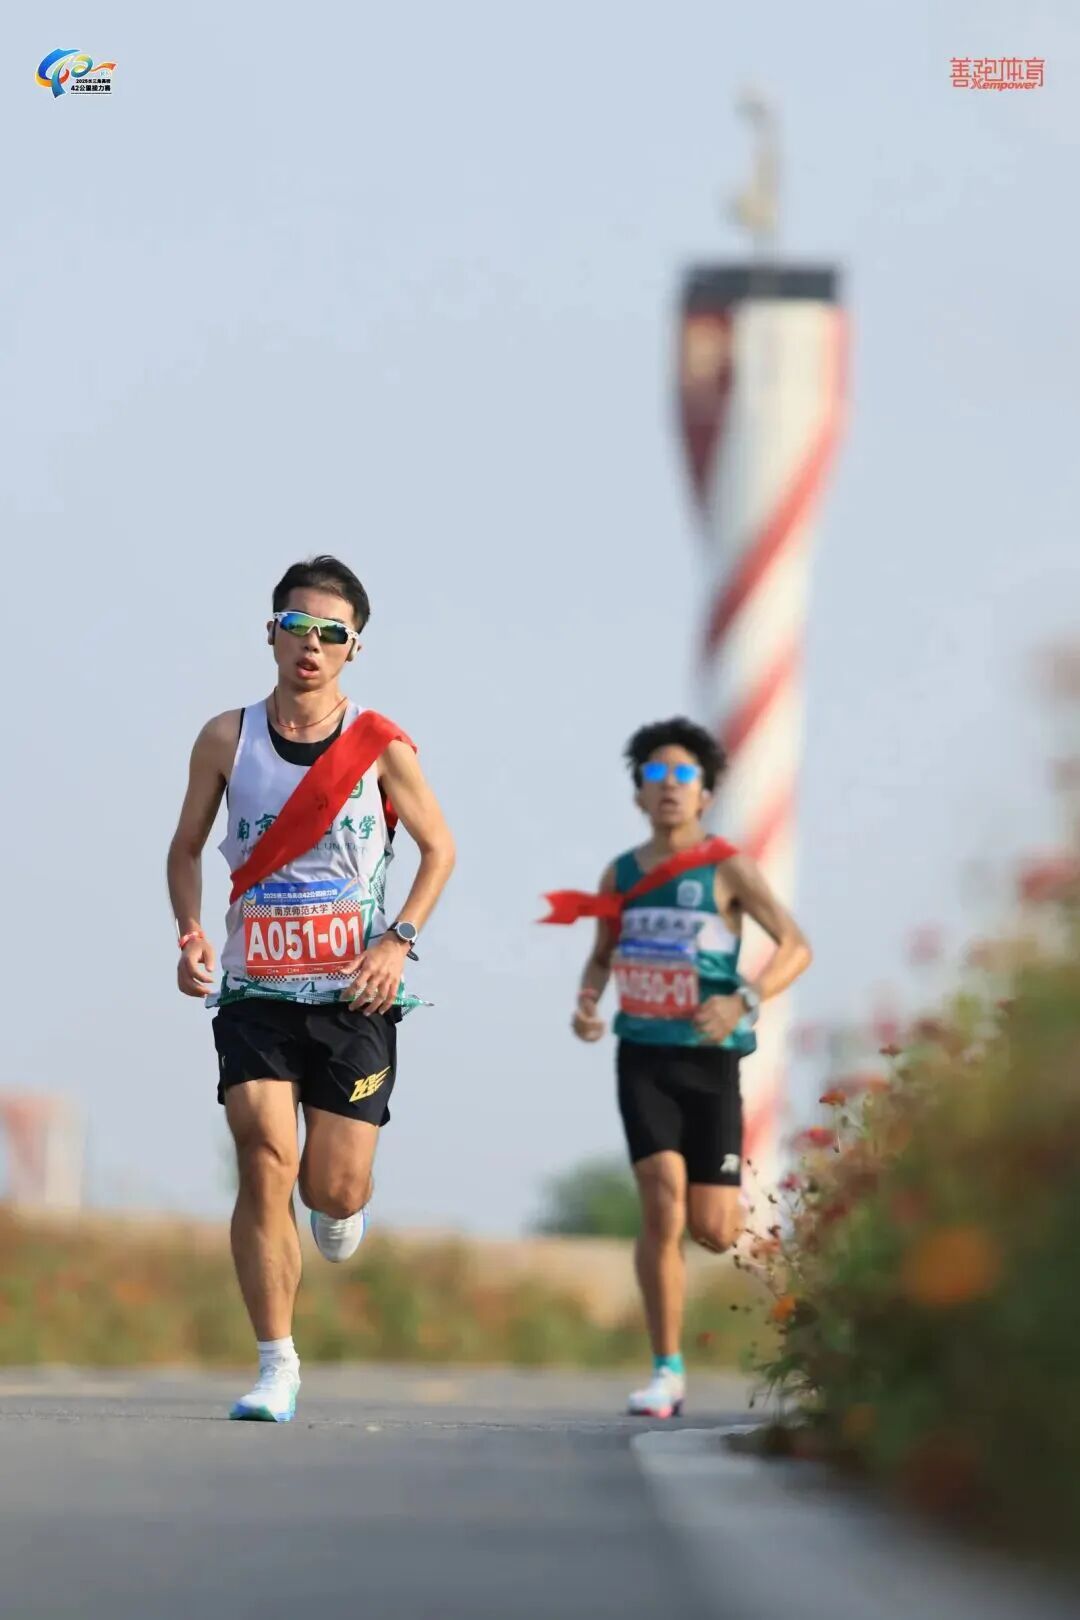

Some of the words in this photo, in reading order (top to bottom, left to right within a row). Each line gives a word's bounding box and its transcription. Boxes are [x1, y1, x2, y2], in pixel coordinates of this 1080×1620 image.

[237, 813, 376, 841] 南京大学
[274, 904, 329, 916] 南京师范大学
[247, 916, 361, 960] A051-01
